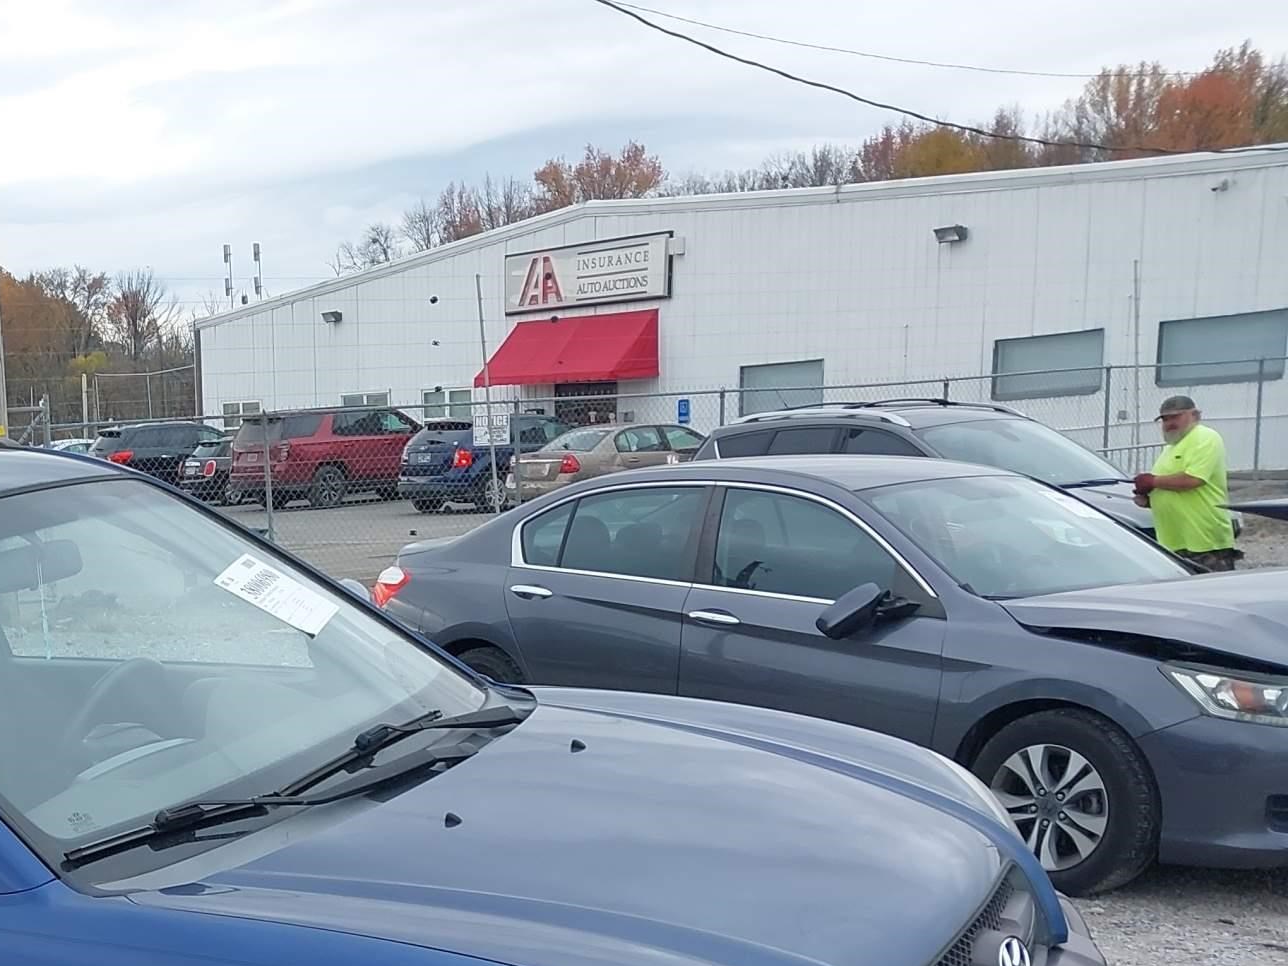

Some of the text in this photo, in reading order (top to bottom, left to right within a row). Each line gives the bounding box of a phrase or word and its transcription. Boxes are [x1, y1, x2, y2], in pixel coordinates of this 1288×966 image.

[577, 250, 649, 271] INSURANCE
[577, 275, 648, 295] AUTO AUCTIONS
[474, 415, 508, 427] NOICE
